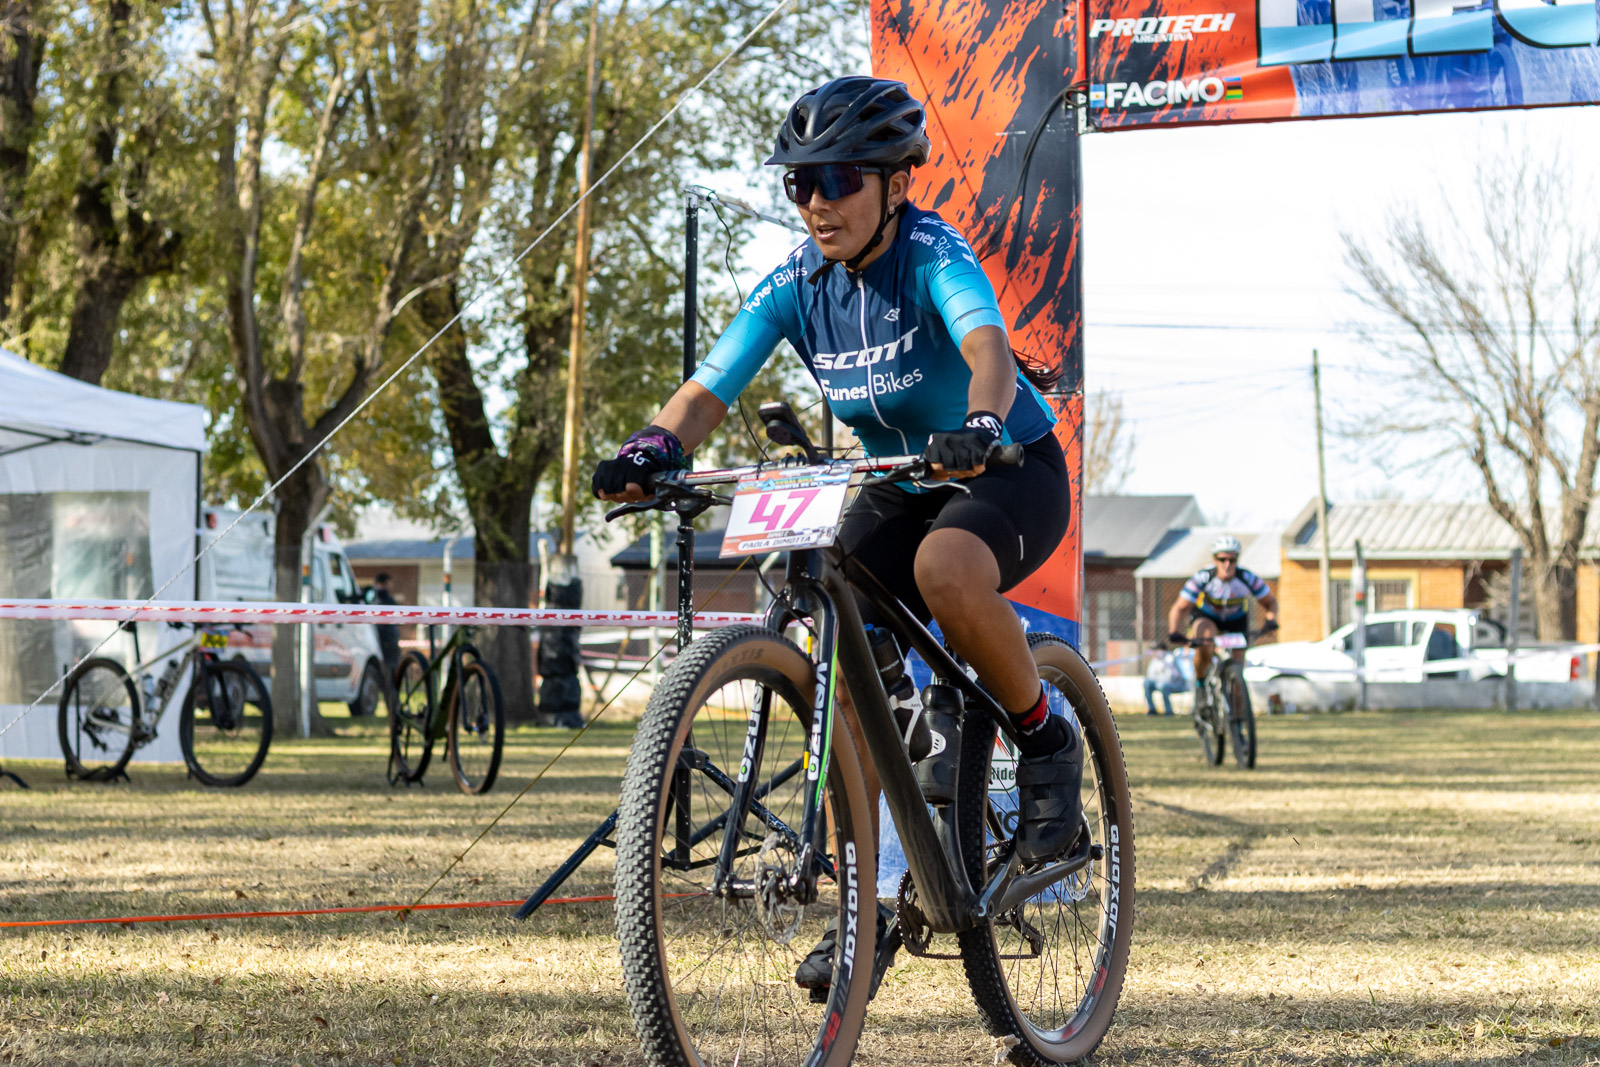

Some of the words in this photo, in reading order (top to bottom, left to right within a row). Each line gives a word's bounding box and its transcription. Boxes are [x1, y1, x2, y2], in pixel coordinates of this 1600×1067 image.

[1089, 13, 1236, 38] PROTECH
[1131, 31, 1194, 44] ARGENTINA
[1106, 77, 1225, 108] FACIMO
[910, 227, 937, 247] unes
[773, 265, 808, 288] Bikes
[812, 326, 919, 370] SCOTT
[820, 379, 869, 401] Funes
[872, 368, 923, 395] Bikes
[748, 488, 822, 531] 47
[737, 681, 764, 783] enzo
